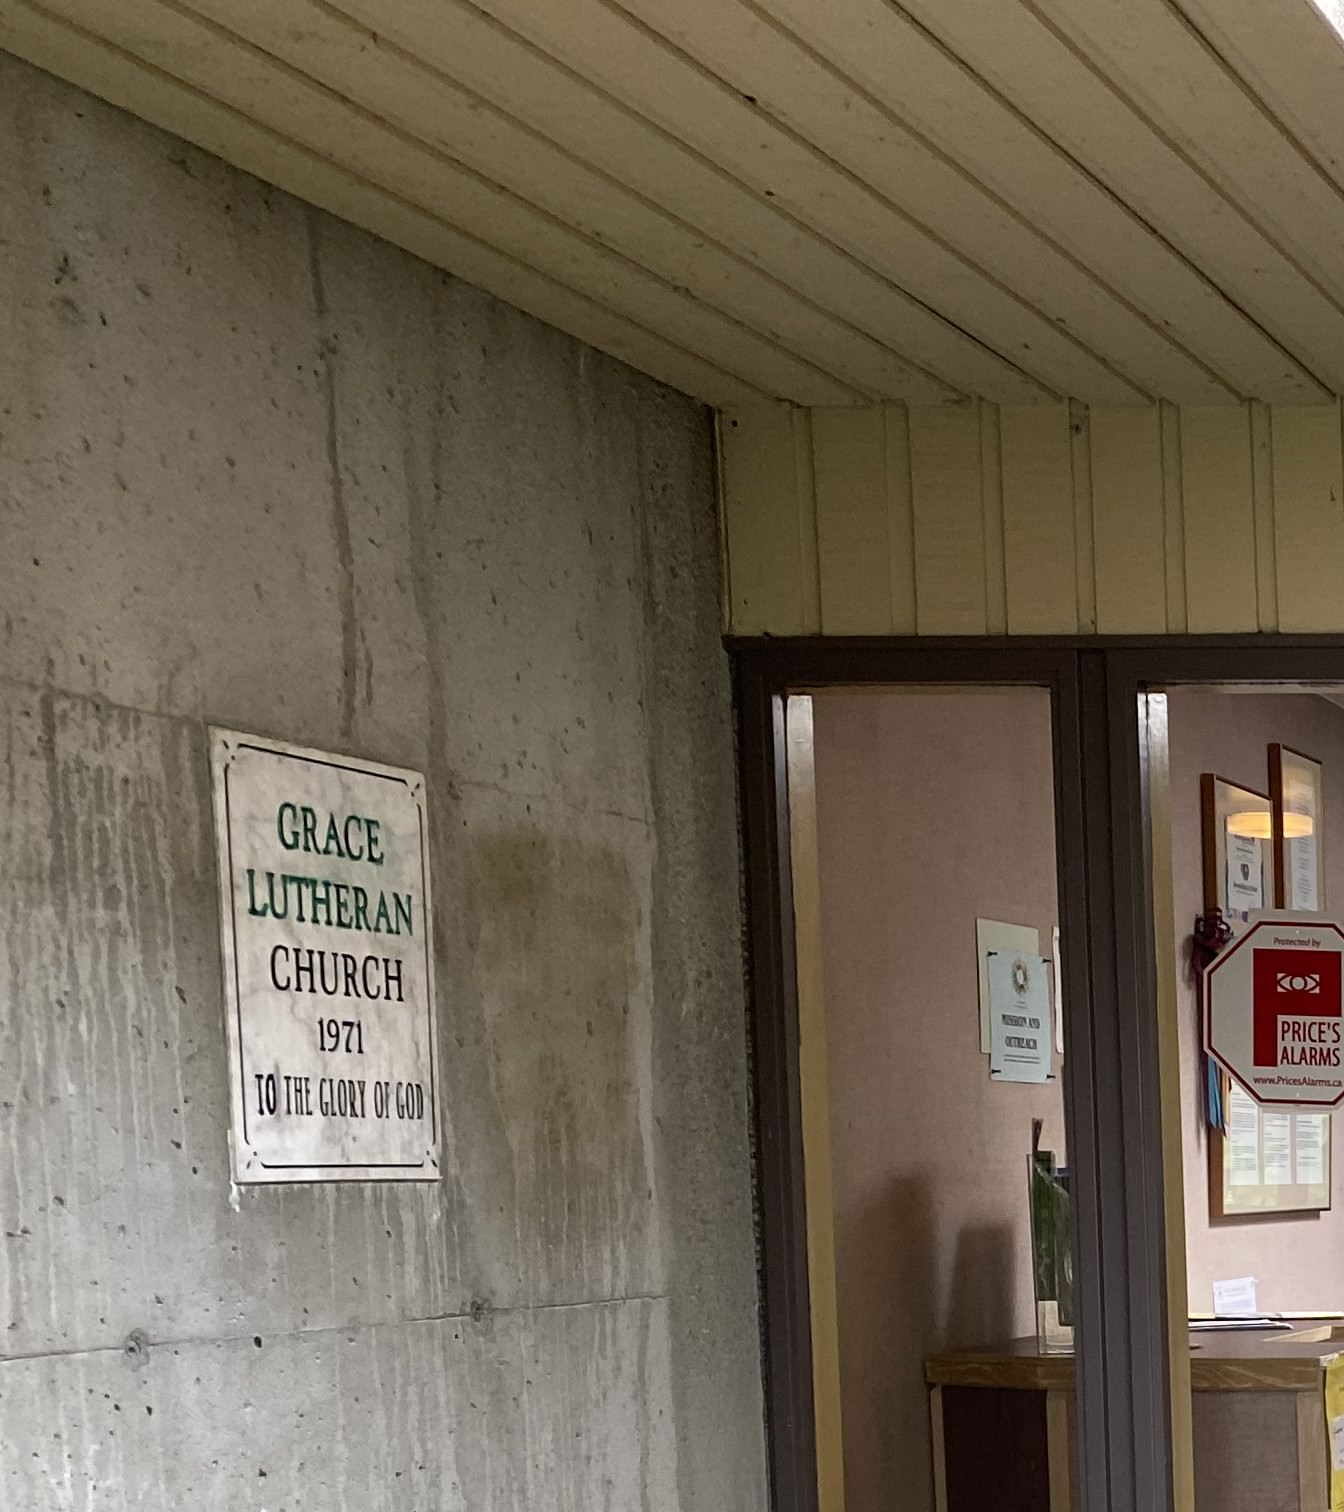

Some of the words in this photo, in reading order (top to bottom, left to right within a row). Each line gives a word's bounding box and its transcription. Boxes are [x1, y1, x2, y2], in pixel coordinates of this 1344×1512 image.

[277, 802, 384, 865] GRACE
[246, 869, 413, 936] LUTHERAN
[1273, 937, 1311, 947] Protected
[1312, 938, 1321, 948] by
[270, 944, 404, 1002] CHURCH
[318, 1017, 364, 1054] 1971
[1281, 1021, 1341, 1043] PRICE'S
[1280, 1046, 1341, 1067] ALARMS
[254, 1073, 277, 1116] TO
[284, 1076, 312, 1116] THE
[319, 1078, 366, 1118] GLORY
[374, 1081, 390, 1119] OF
[396, 1082, 424, 1120] GOD
[1253, 1076, 1343, 1088] www.PricesAlarms.ca
